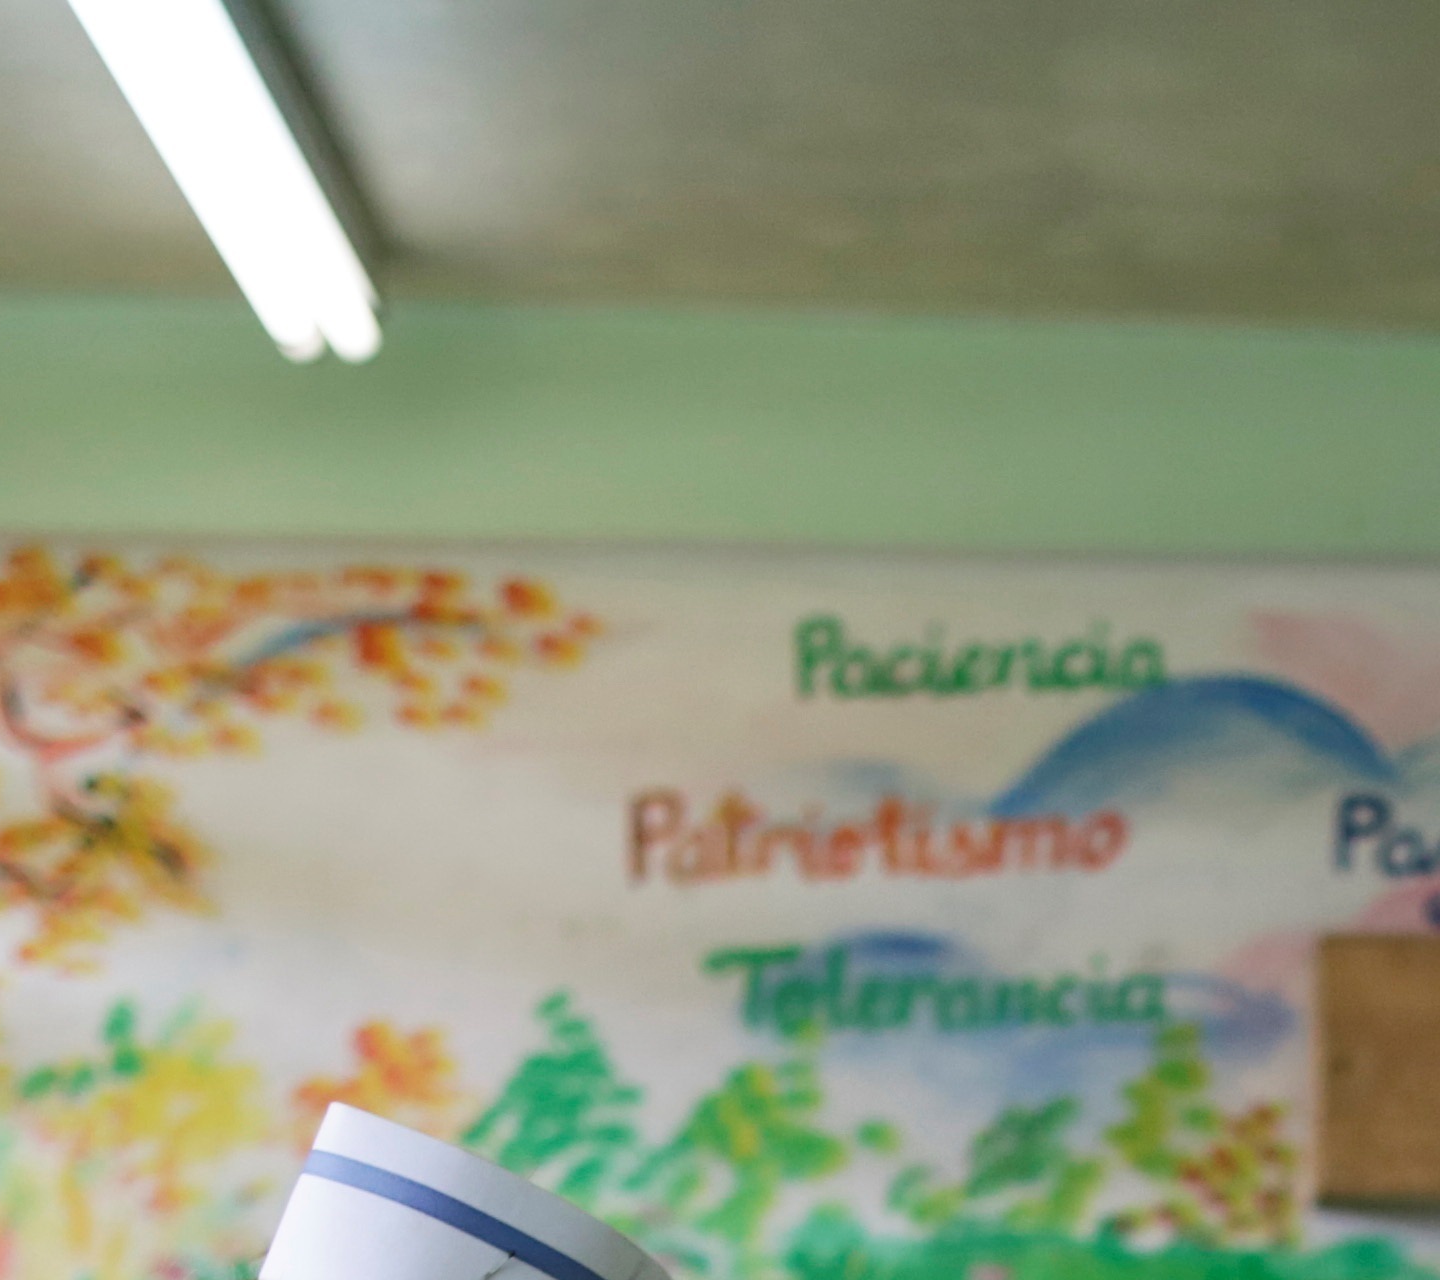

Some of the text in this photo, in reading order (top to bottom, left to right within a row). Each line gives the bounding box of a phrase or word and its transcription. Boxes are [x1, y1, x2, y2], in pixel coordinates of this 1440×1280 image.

[794, 617, 1166, 699] Paciencia
[626, 790, 1130, 886] Patriotismo
[705, 943, 1165, 1040] Tolerancia
